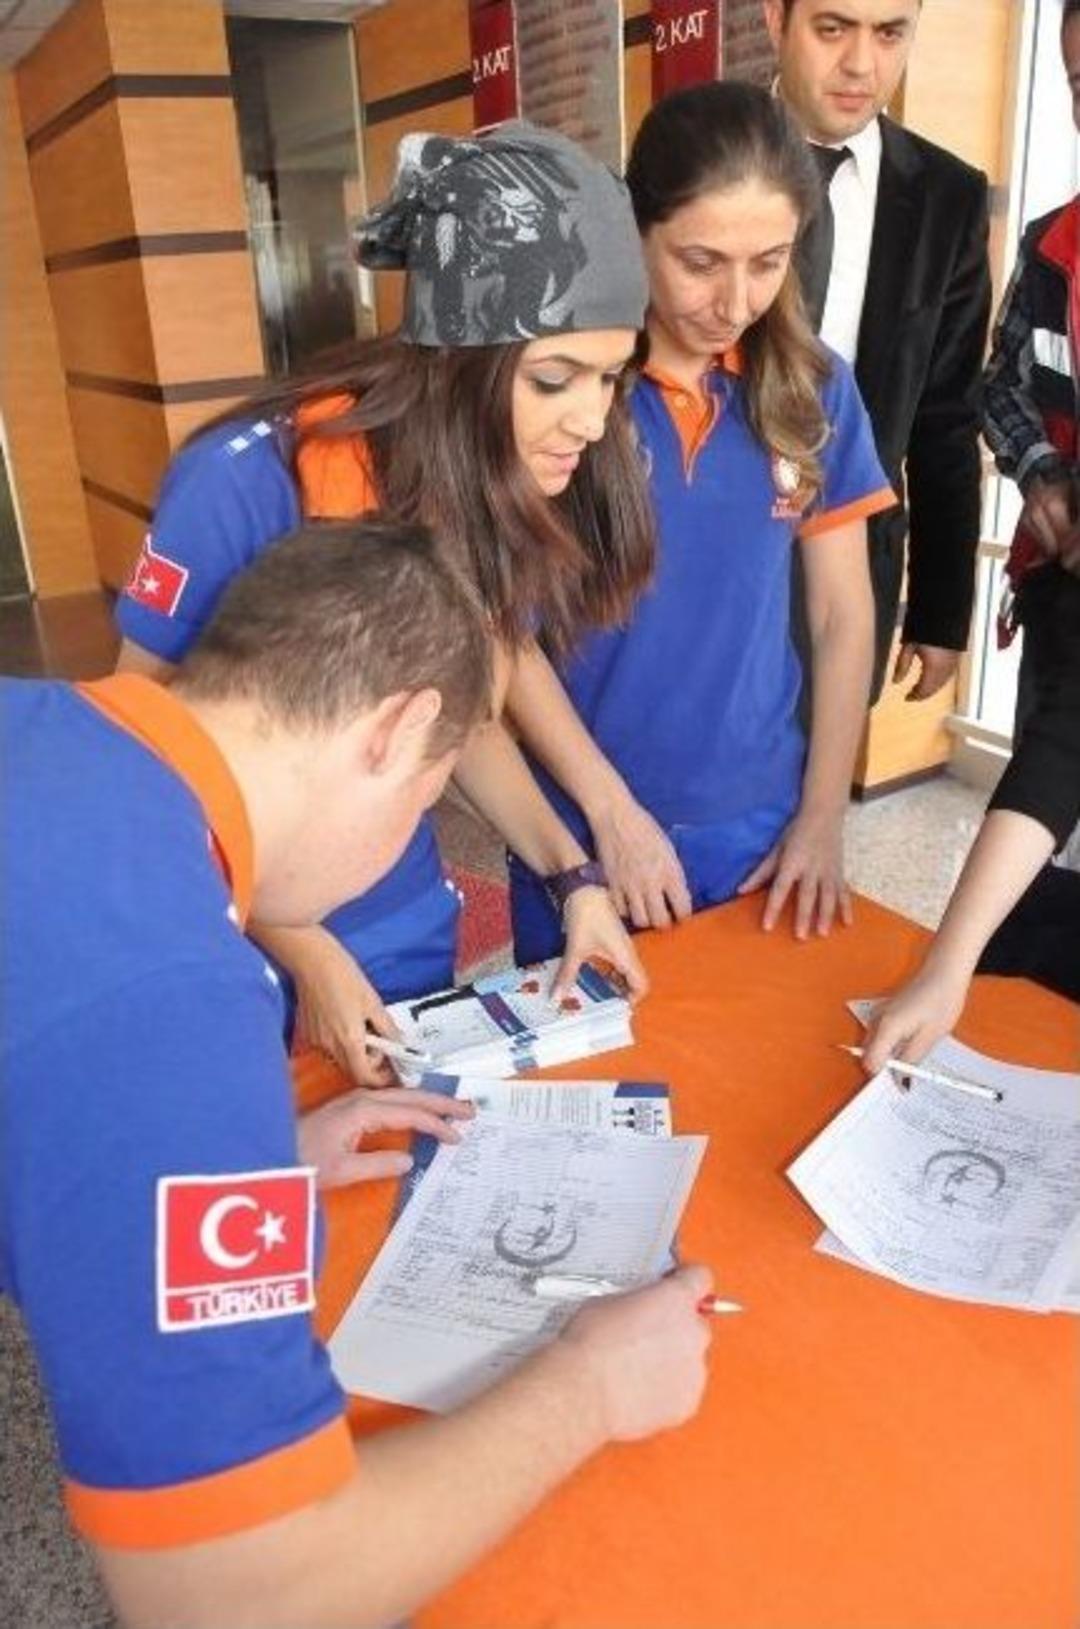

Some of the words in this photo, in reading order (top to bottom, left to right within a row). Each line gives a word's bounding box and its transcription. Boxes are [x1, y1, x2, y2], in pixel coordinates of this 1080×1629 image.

[670, 10, 709, 46] KAT
[483, 45, 511, 78] KAT
[186, 1282, 299, 1321] TÜRKİYE
